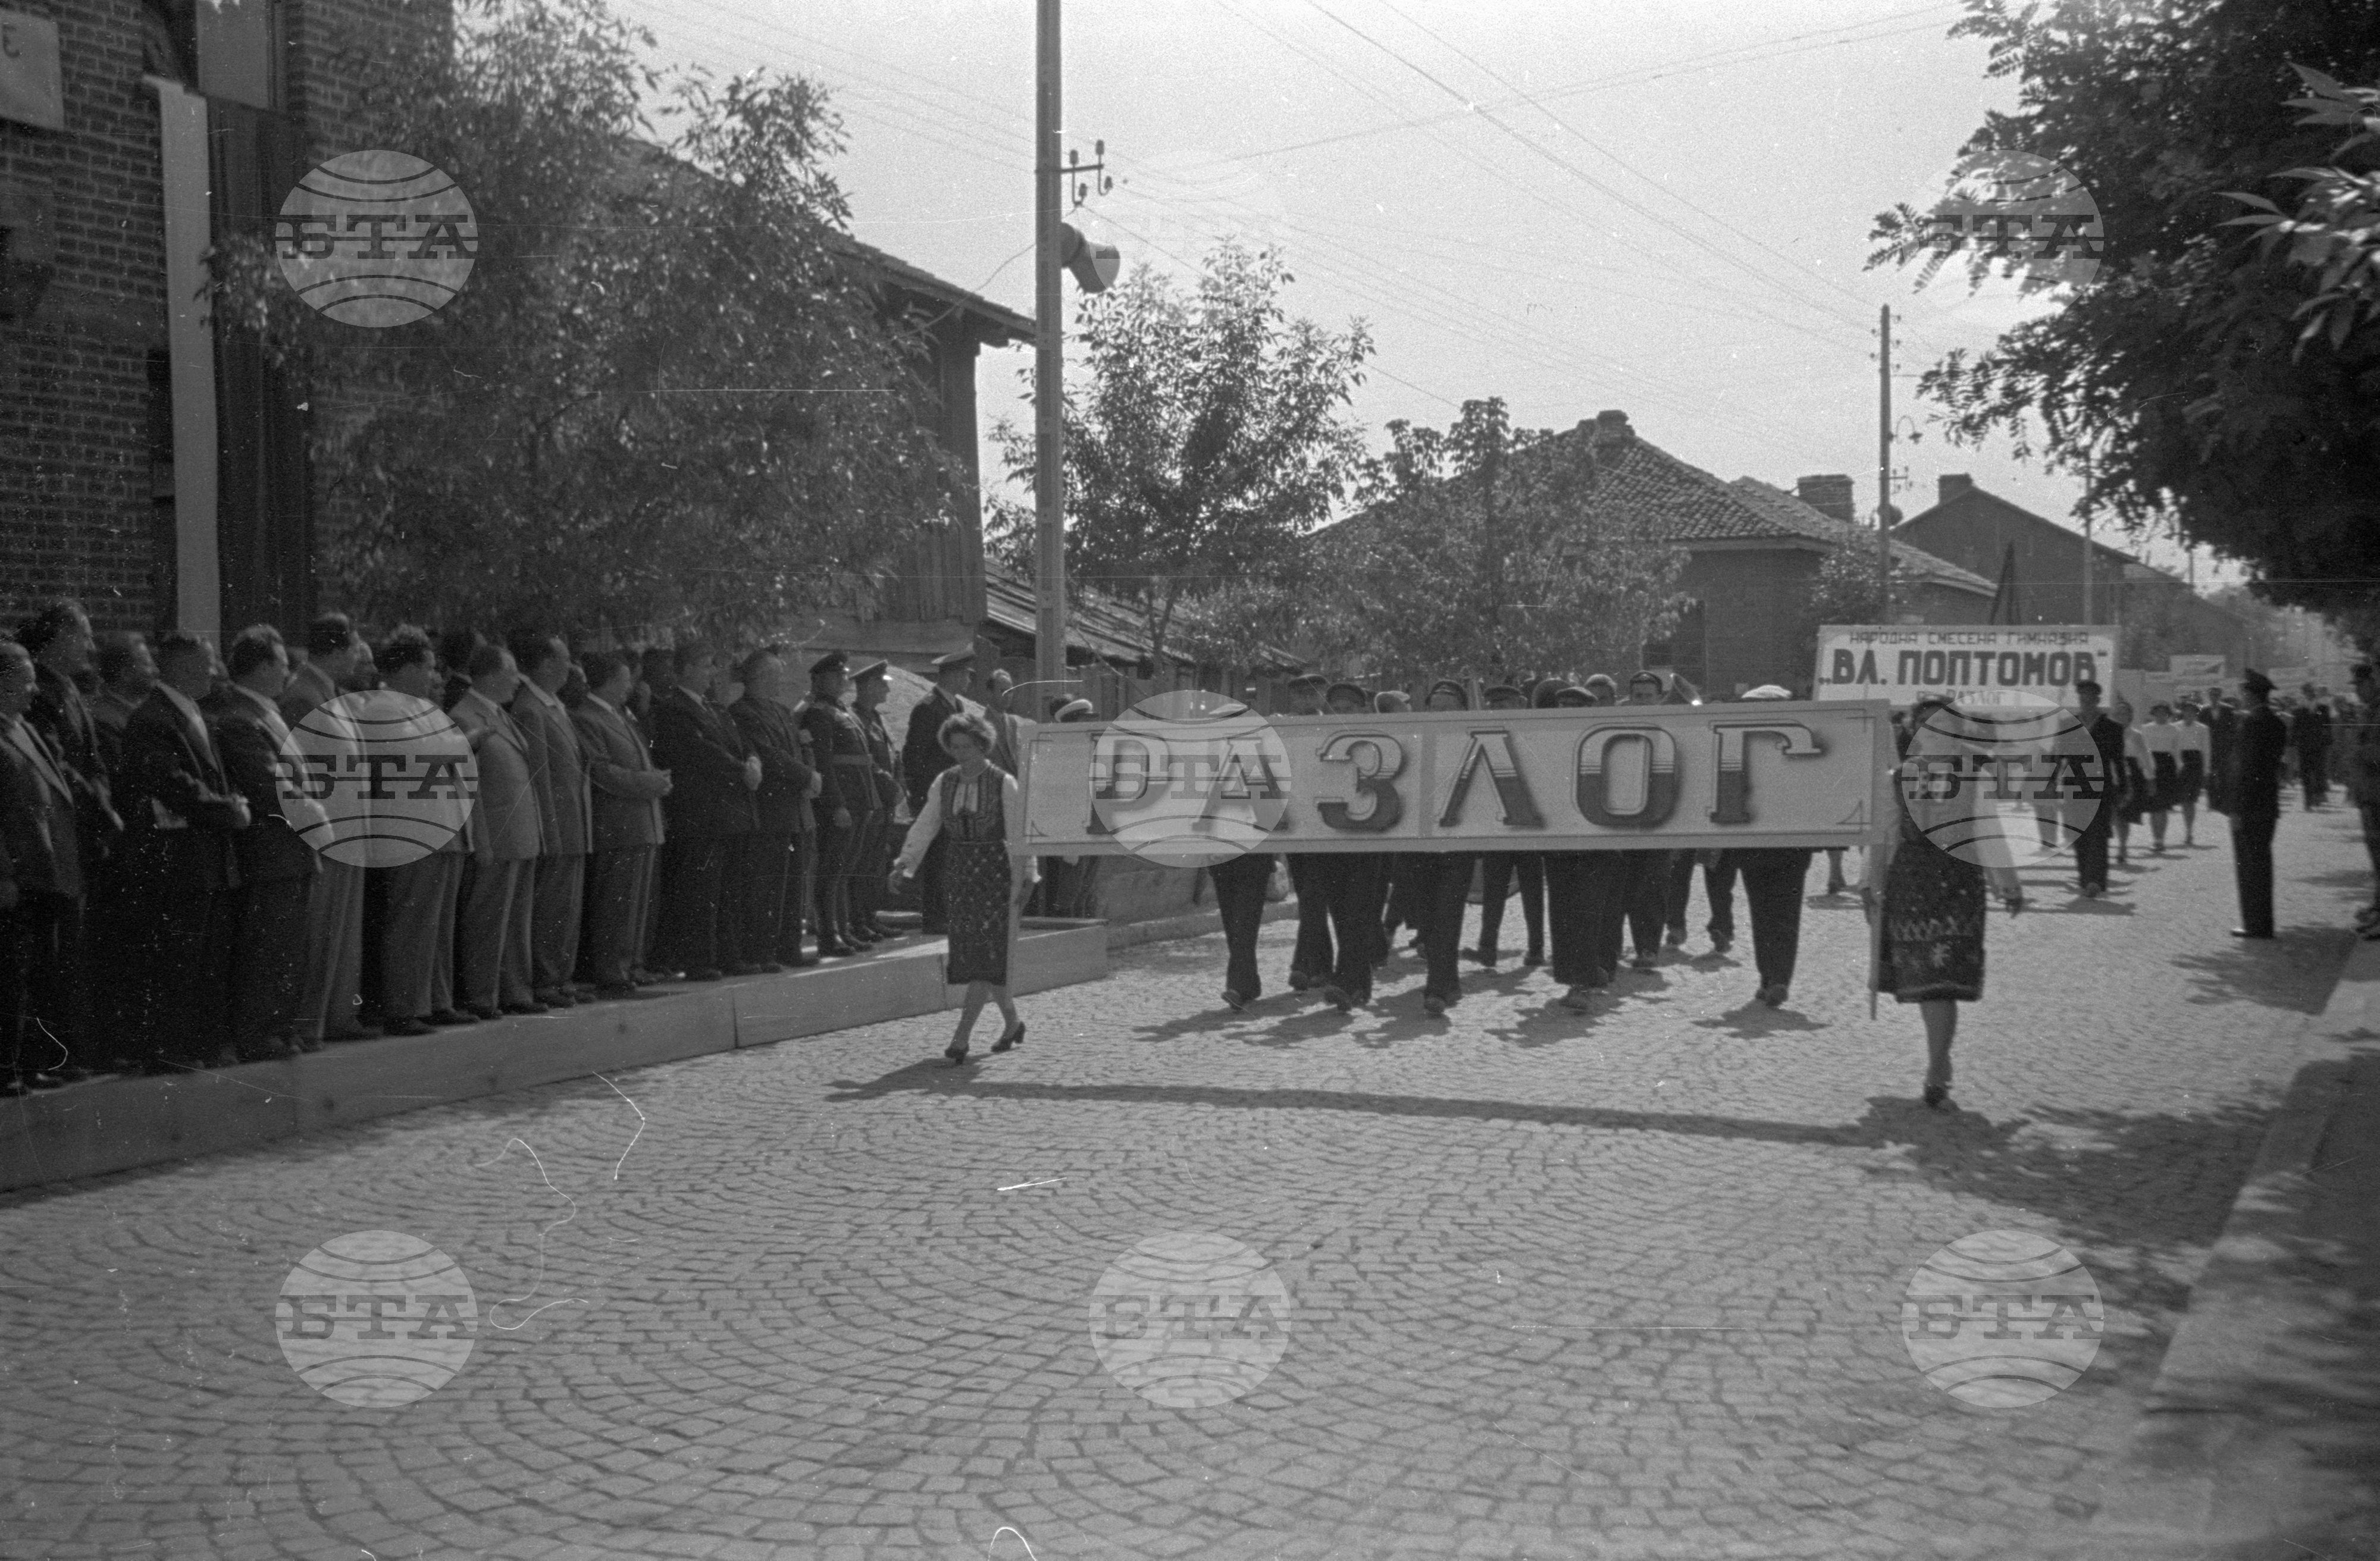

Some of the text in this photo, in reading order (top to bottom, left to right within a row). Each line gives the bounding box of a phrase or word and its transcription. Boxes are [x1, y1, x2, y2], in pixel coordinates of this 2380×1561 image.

[1849, 631, 1918, 644] НАРОДНА
[1928, 632, 1997, 645] СМЕСЕНА
[1085, 720, 1824, 835] РАЗЛОГ
